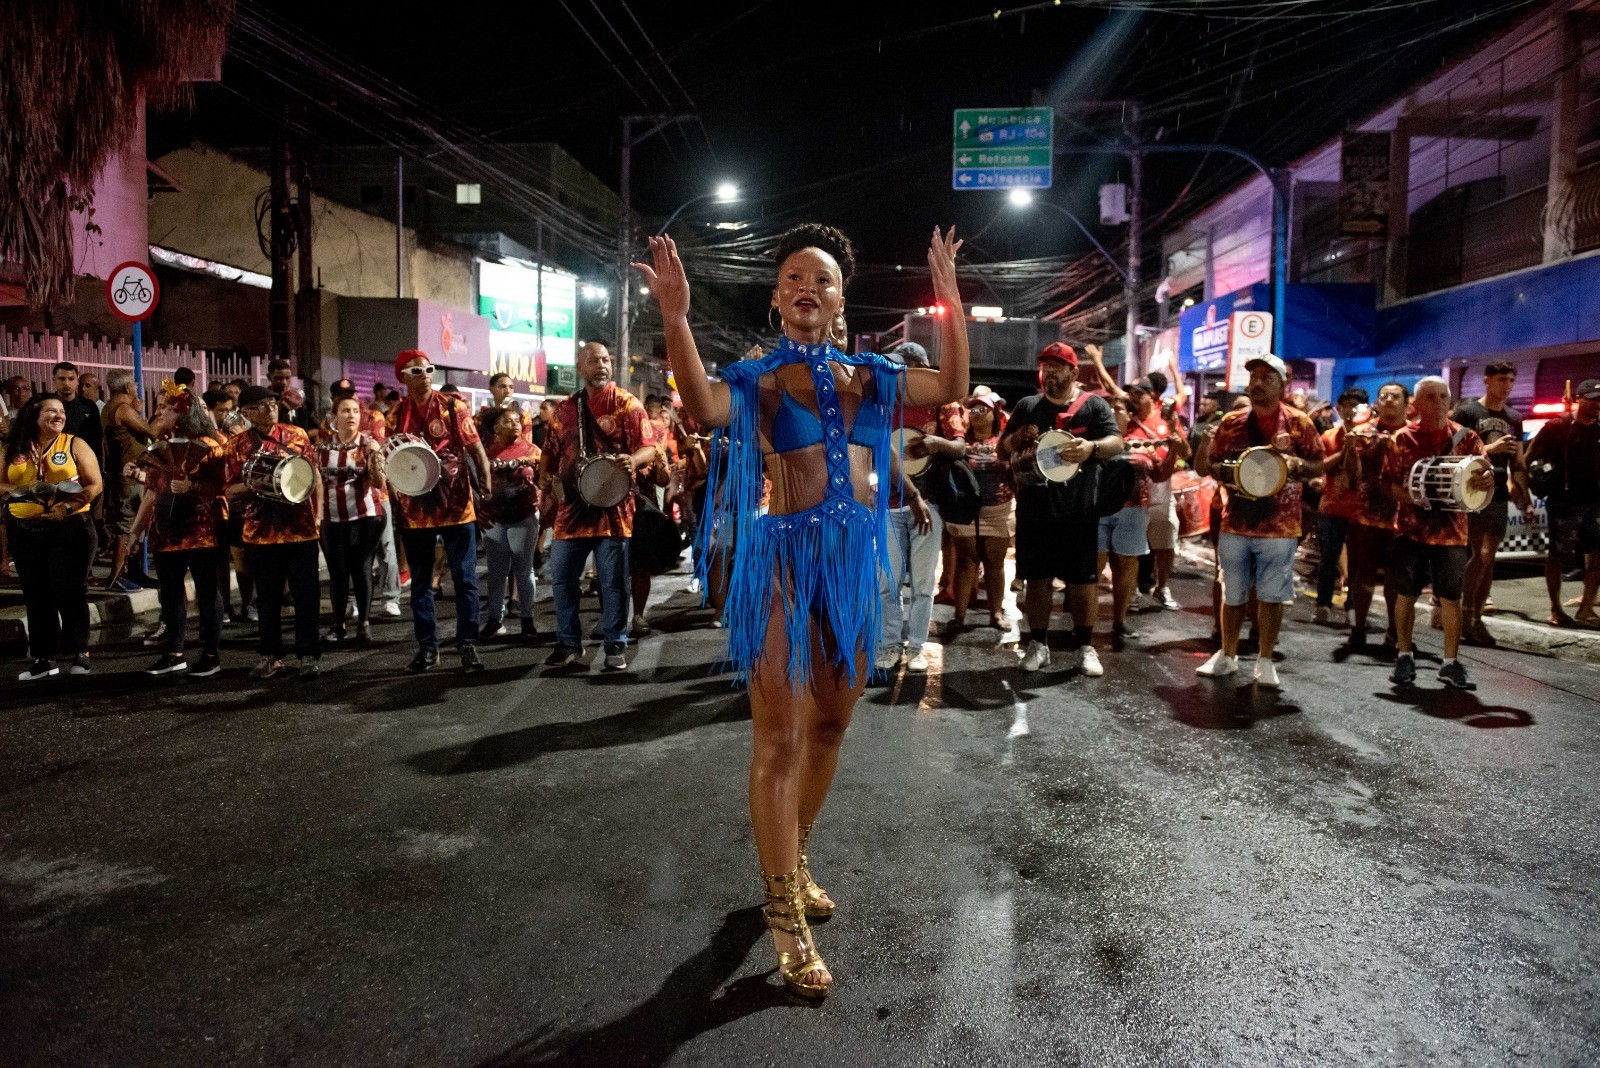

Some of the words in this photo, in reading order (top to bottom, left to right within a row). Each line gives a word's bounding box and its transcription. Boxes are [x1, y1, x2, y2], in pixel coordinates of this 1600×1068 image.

[978, 154, 1030, 164] Retorno
[978, 173, 1042, 185] Delegacia
[1248, 320, 1257, 333] E
[509, 351, 537, 383] BORA
